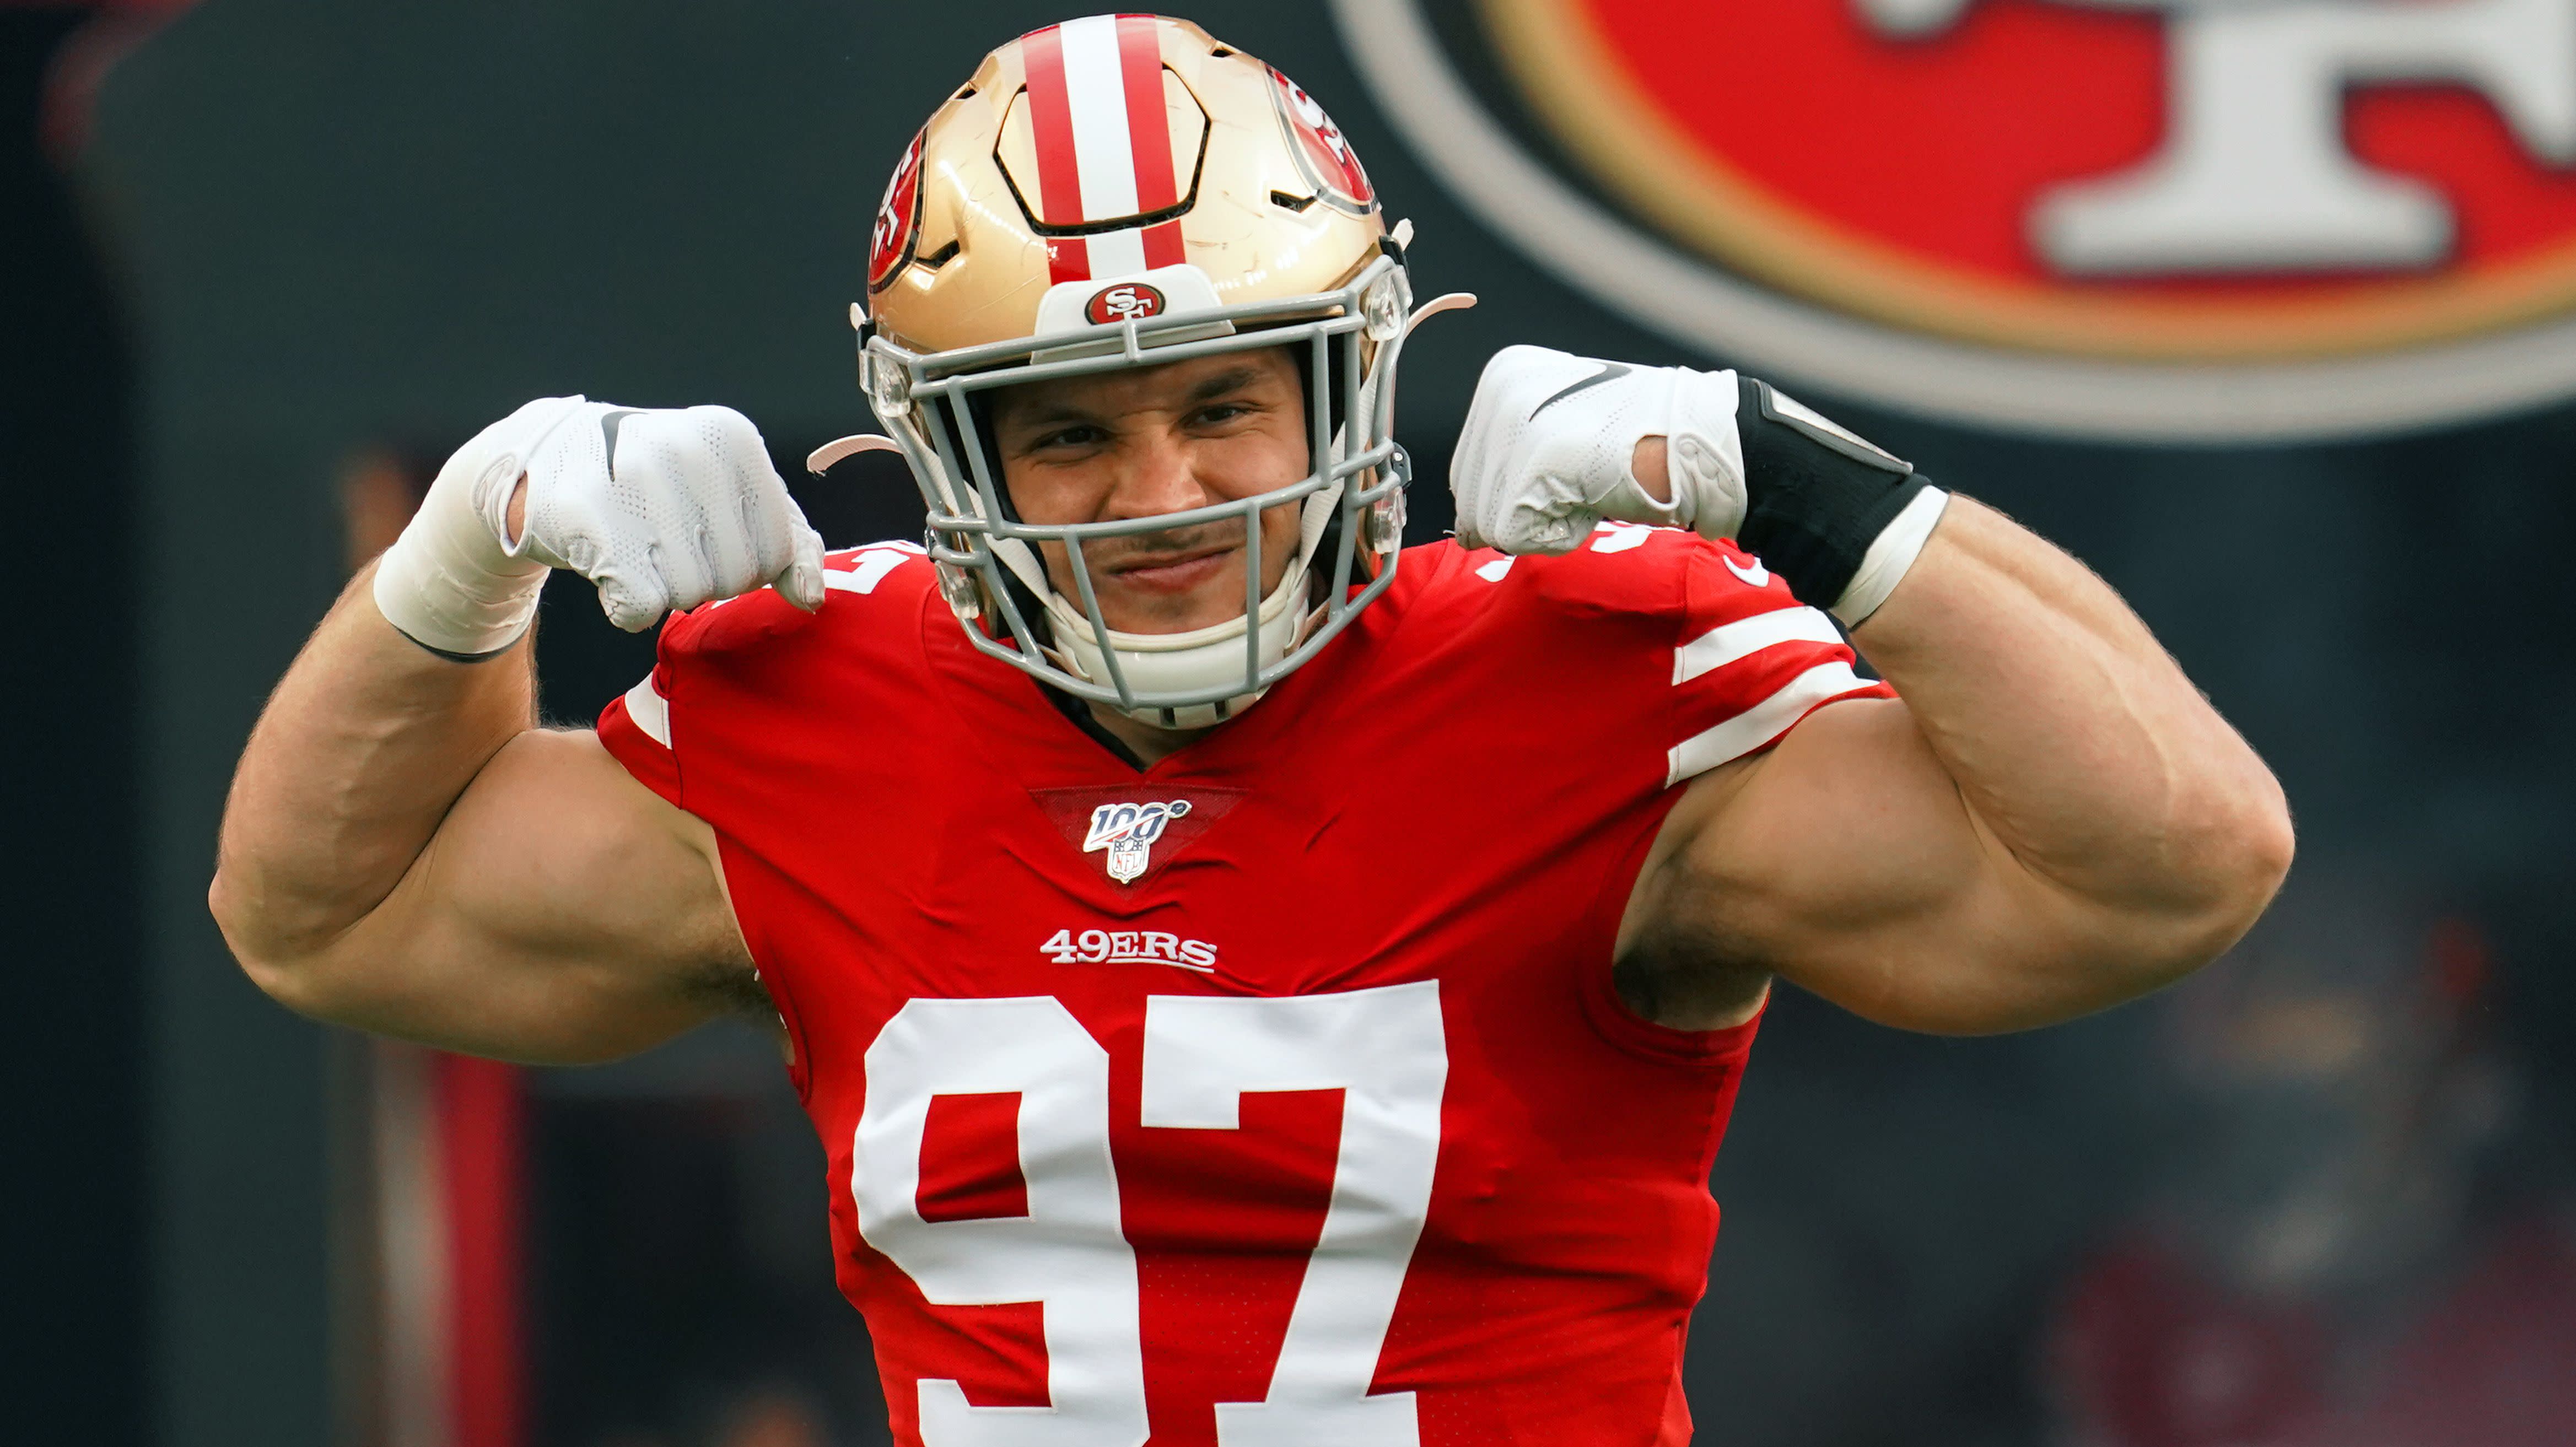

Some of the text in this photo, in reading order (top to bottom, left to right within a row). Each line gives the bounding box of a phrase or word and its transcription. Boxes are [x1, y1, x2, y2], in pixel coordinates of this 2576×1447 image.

[1094, 807, 1165, 843] 100
[1114, 852, 1139, 872] NFL
[1040, 930, 1217, 967] 49ERS
[851, 979, 1448, 1447] 97
